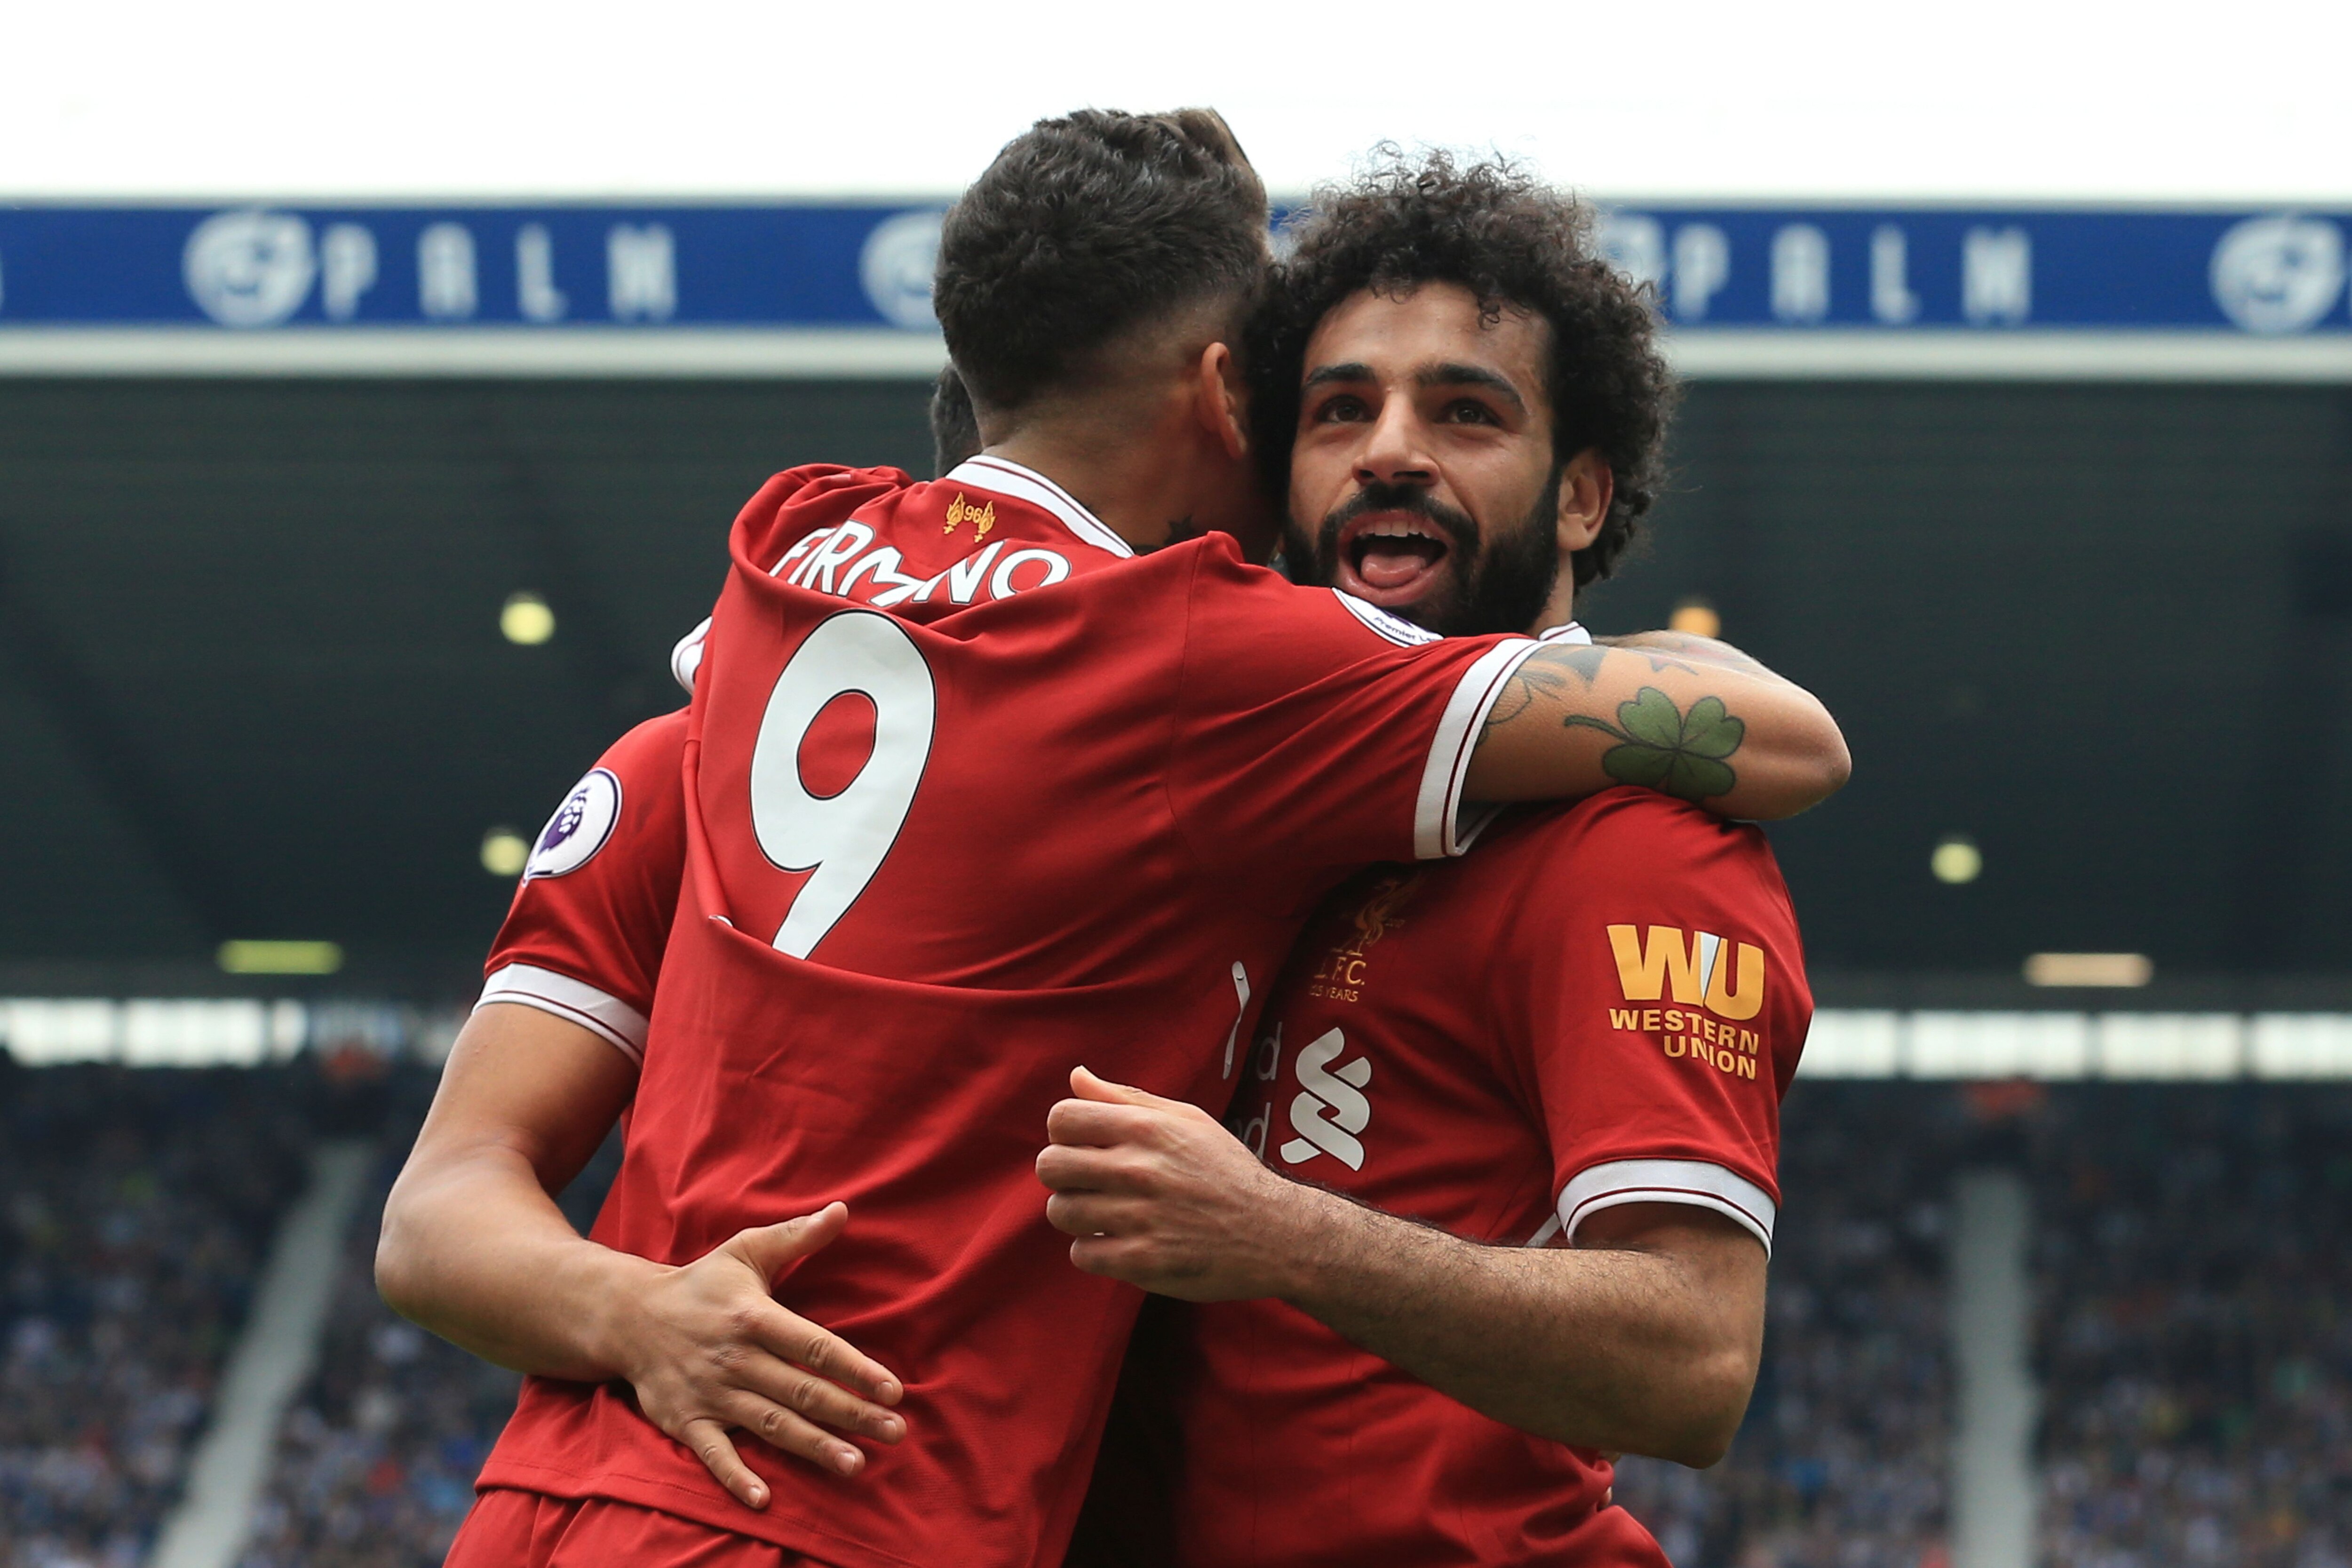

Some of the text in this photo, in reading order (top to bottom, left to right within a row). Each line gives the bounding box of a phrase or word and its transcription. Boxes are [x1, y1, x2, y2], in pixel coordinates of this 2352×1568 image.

[320, 222, 677, 322] PALM
[1672, 223, 2032, 324] PALM
[963, 505, 983, 524] 96
[768, 518, 1072, 607] FIRMNO
[1374, 616, 1416, 639] Premier
[749, 608, 937, 961] 9
[1325, 986, 1359, 1003] YEARS
[1606, 924, 1764, 1021] WU
[1609, 1008, 1759, 1055] WESTERN
[1663, 1035, 1756, 1080] UNION
